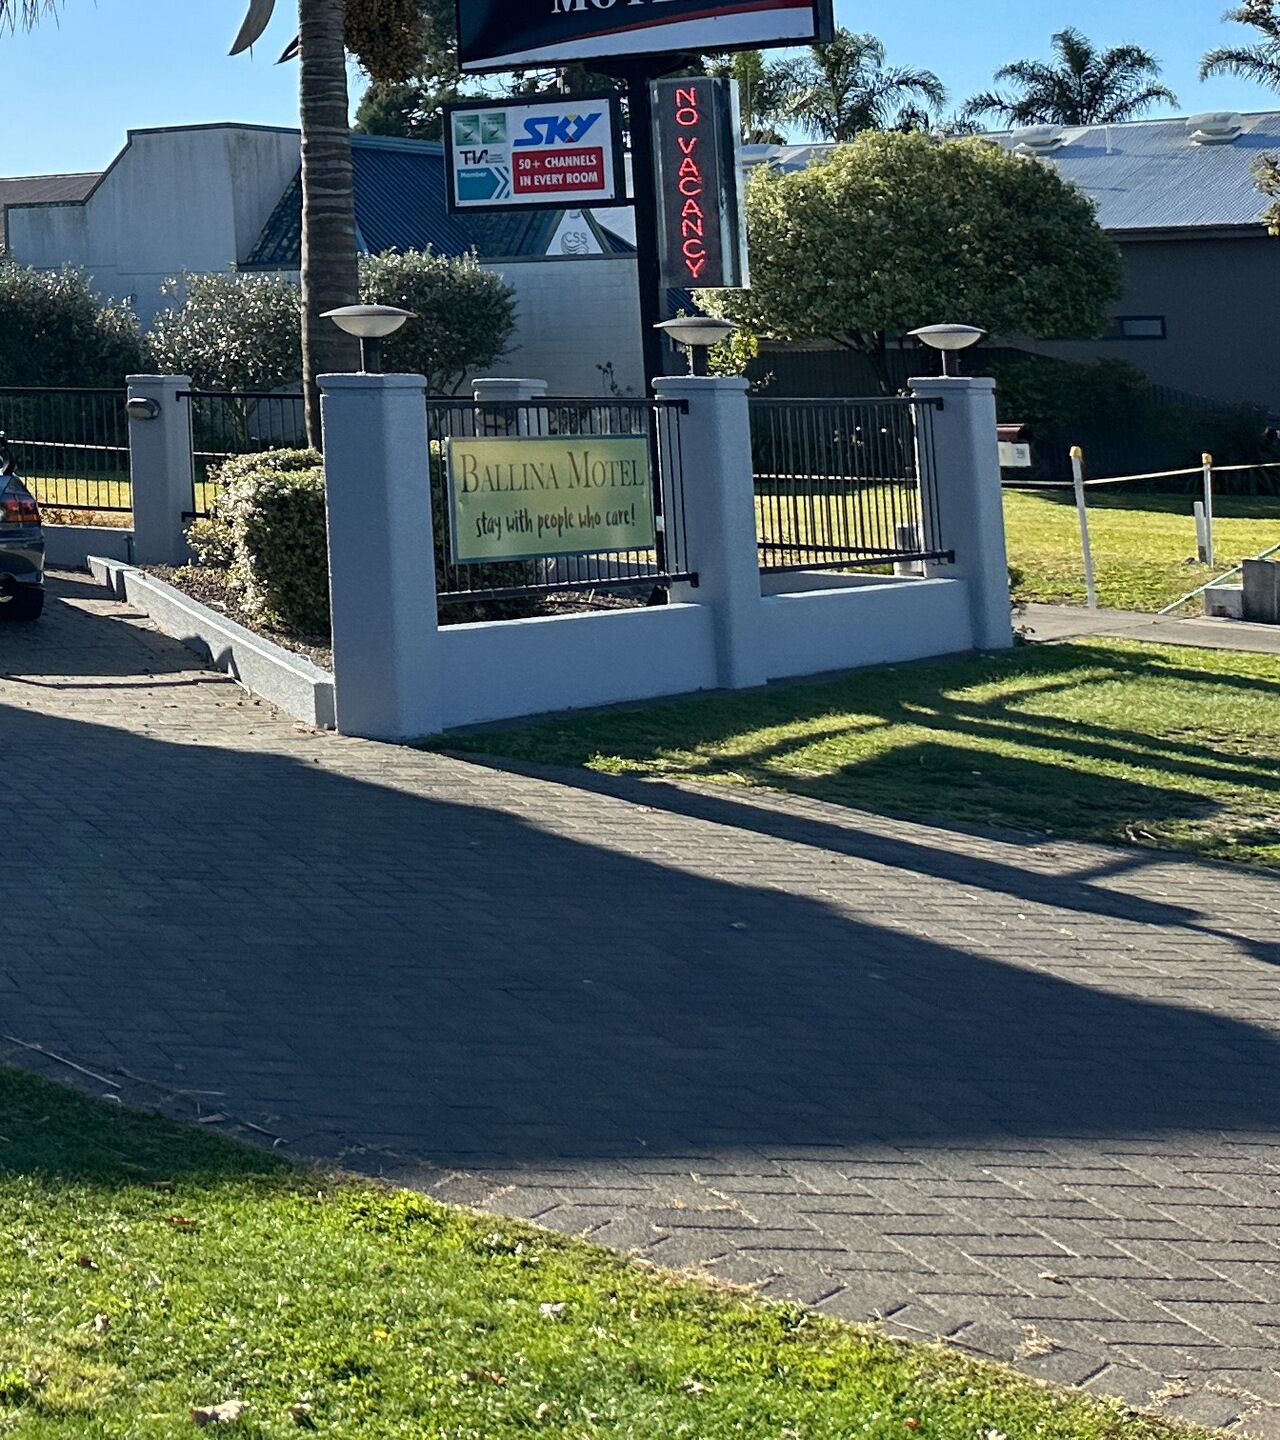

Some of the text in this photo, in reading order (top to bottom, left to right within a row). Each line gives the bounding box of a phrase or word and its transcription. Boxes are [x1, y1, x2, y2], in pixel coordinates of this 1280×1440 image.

[513, 112, 602, 147] SKY
[544, 154, 597, 168] CHANNELS
[519, 172, 598, 186] IN EVERY ROOM
[674, 87, 706, 278] NO VACANCY
[565, 231, 588, 244] CSS
[460, 450, 645, 493] BALLINA MOTEL
[475, 502, 636, 541] stay with people who care!
